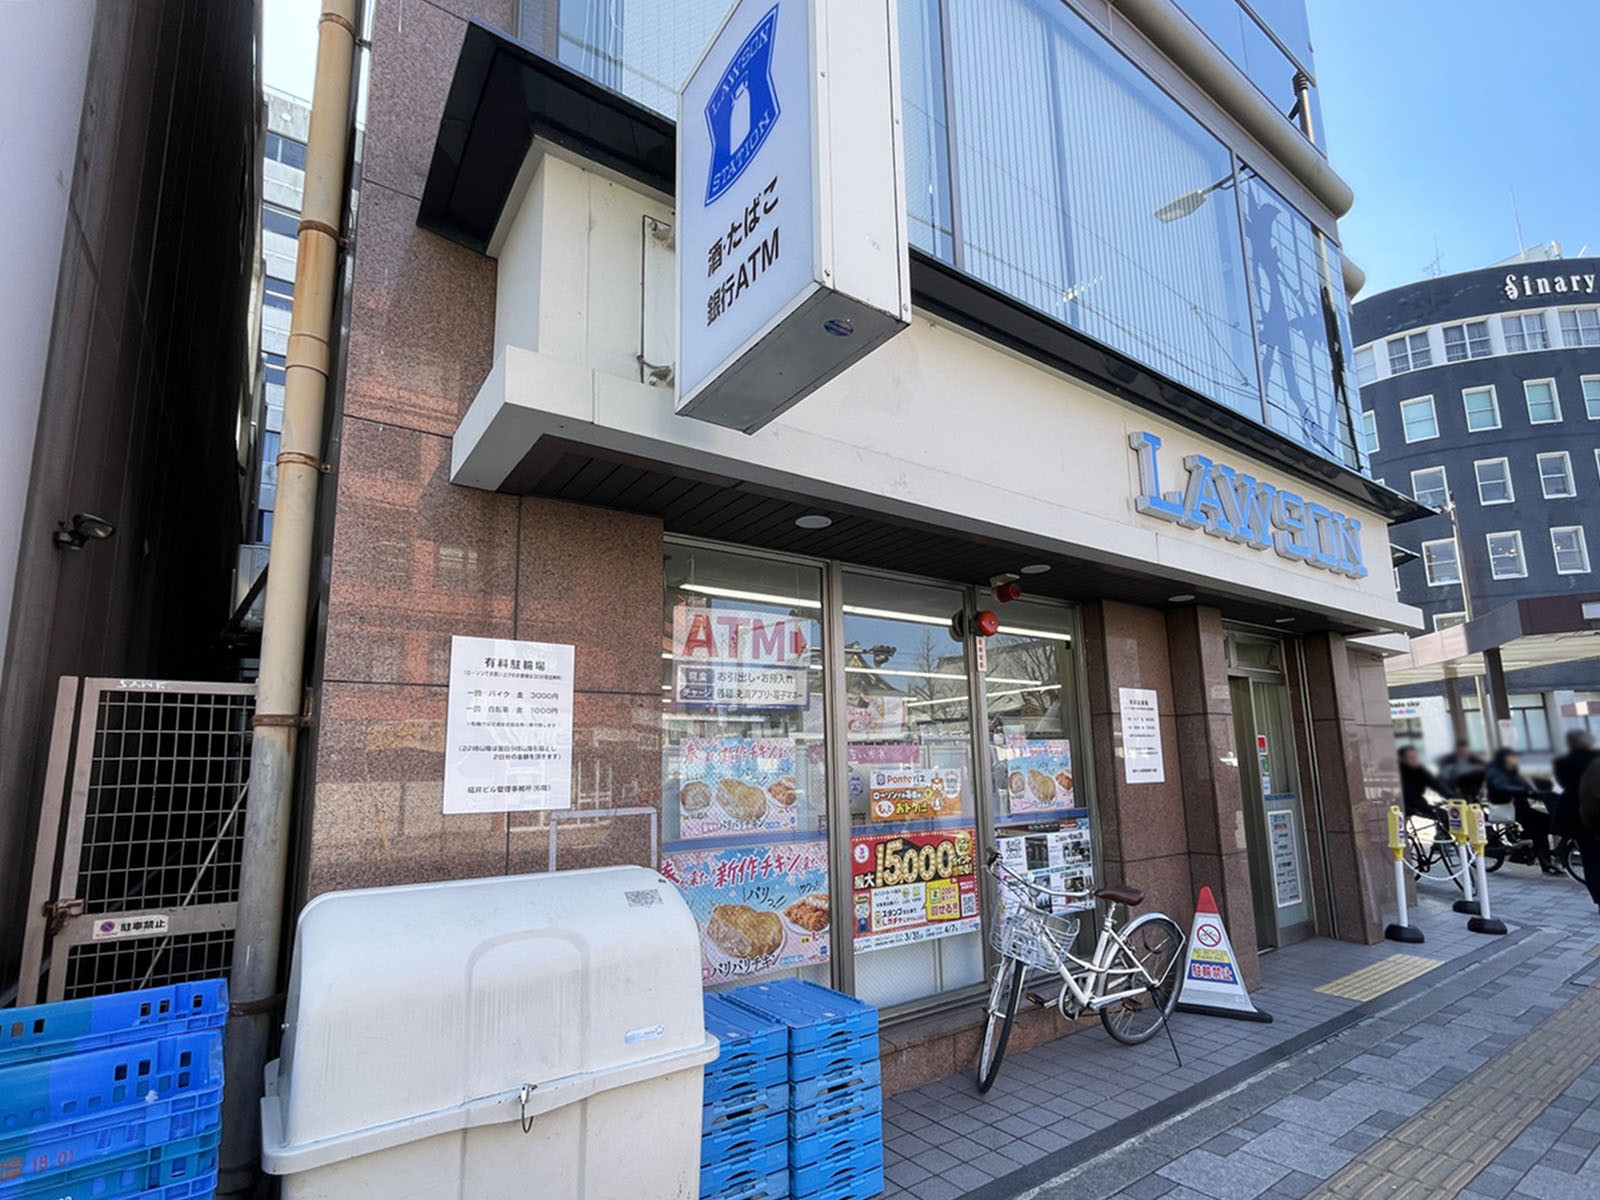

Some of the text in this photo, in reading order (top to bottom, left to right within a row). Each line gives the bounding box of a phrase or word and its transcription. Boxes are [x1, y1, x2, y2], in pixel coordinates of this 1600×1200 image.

[711, 23, 771, 116] LAWSON
[711, 110, 771, 193] STATION
[708, 176, 779, 278] 酒・たばこ
[707, 226, 780, 327] 銀行ATM
[1504, 273, 1595, 301] Sinary
[1128, 431, 1368, 580] LAWSON
[681, 614, 786, 662] ATM
[875, 838, 956, 888] 15,000
[120, 920, 166, 932] 駐車禁止
